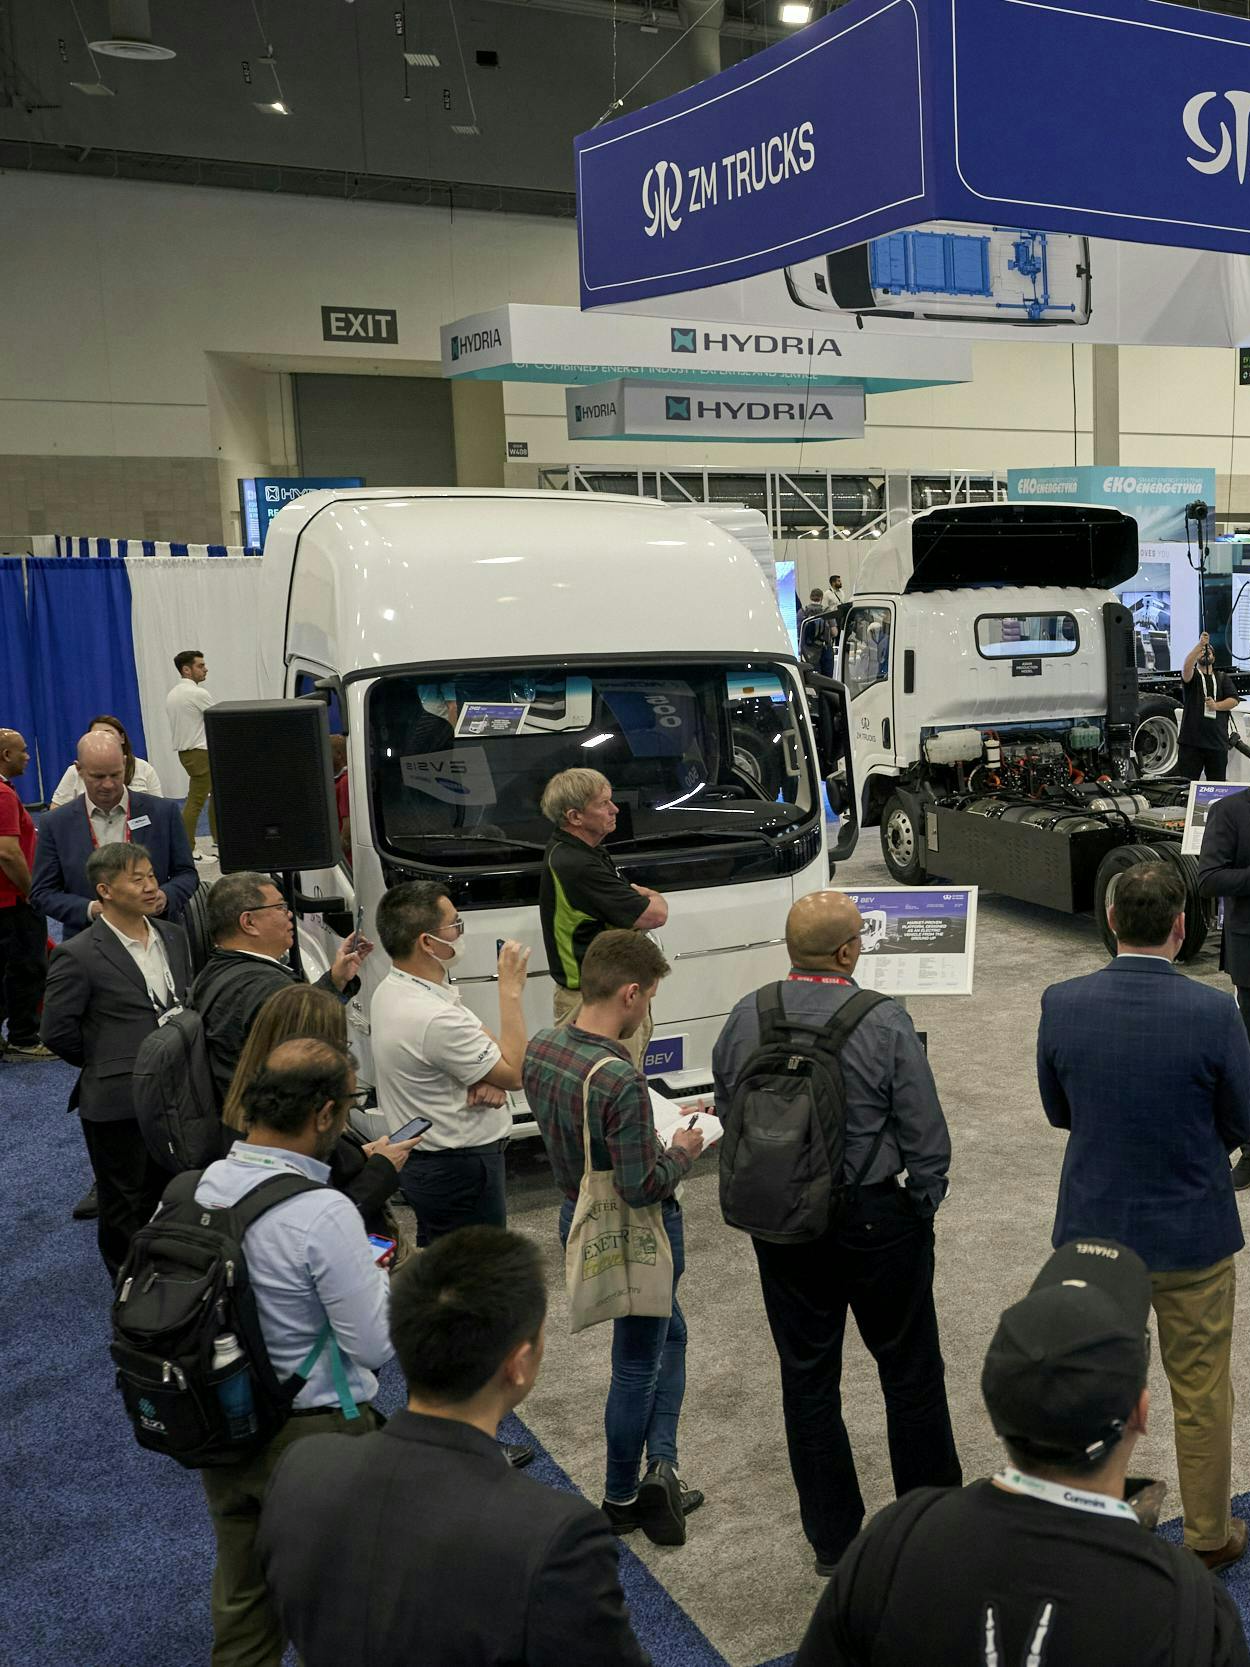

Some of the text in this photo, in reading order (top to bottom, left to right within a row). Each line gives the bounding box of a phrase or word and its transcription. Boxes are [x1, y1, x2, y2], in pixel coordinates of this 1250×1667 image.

[688, 121, 815, 212] ZM TRUCKS
[329, 313, 391, 339] EXIT
[459, 328, 502, 356] HYDRIA
[703, 332, 842, 357] HYDRIA
[582, 402, 617, 419] HYDRIA
[697, 400, 834, 420] HYDRIA
[509, 448, 528, 456] W408
[1017, 478, 1036, 494] EKO
[1103, 477, 1203, 494] EKO ENERGETYKA
[644, 1052, 674, 1066] BEV
[1076, 1243, 1119, 1259] CHANEL
